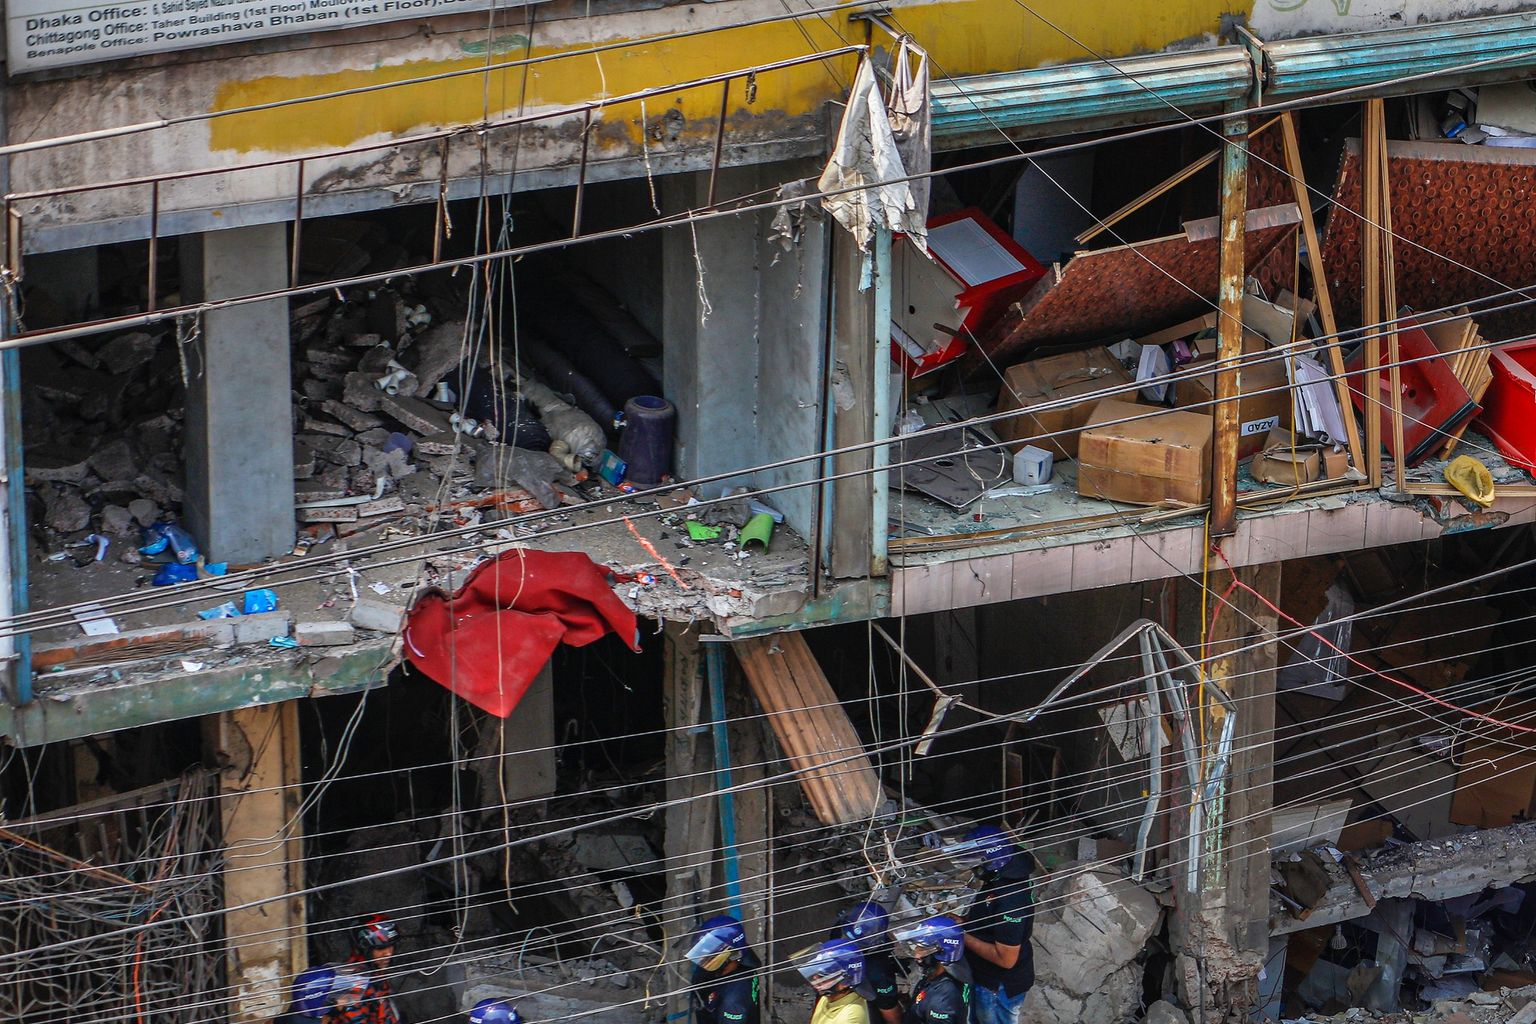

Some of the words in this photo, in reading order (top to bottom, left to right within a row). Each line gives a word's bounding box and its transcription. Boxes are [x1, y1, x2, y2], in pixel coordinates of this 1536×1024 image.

[26, 14, 82, 32] Dhaka
[88, 5, 148, 23] Office:
[26, 29, 100, 48] Chittagong
[104, 22, 148, 36] Office:
[152, 18, 185, 29] Taher
[189, 11, 240, 25] Building
[243, 7, 267, 19] (1st
[270, 2, 306, 14] Floor)
[27, 42, 96, 59] Benapole
[101, 35, 149, 48] Office:
[153, 19, 264, 41] Powrashava
[270, 10, 338, 27] Bhaban
[345, 6, 378, 20] (1st
[1247, 420, 1274, 433] AZAD
[986, 845, 1003, 854] POLICE
[848, 961, 863, 969] POLICE
[724, 1011, 743, 1021] POLICE
[930, 1010, 949, 1020] POLICE
